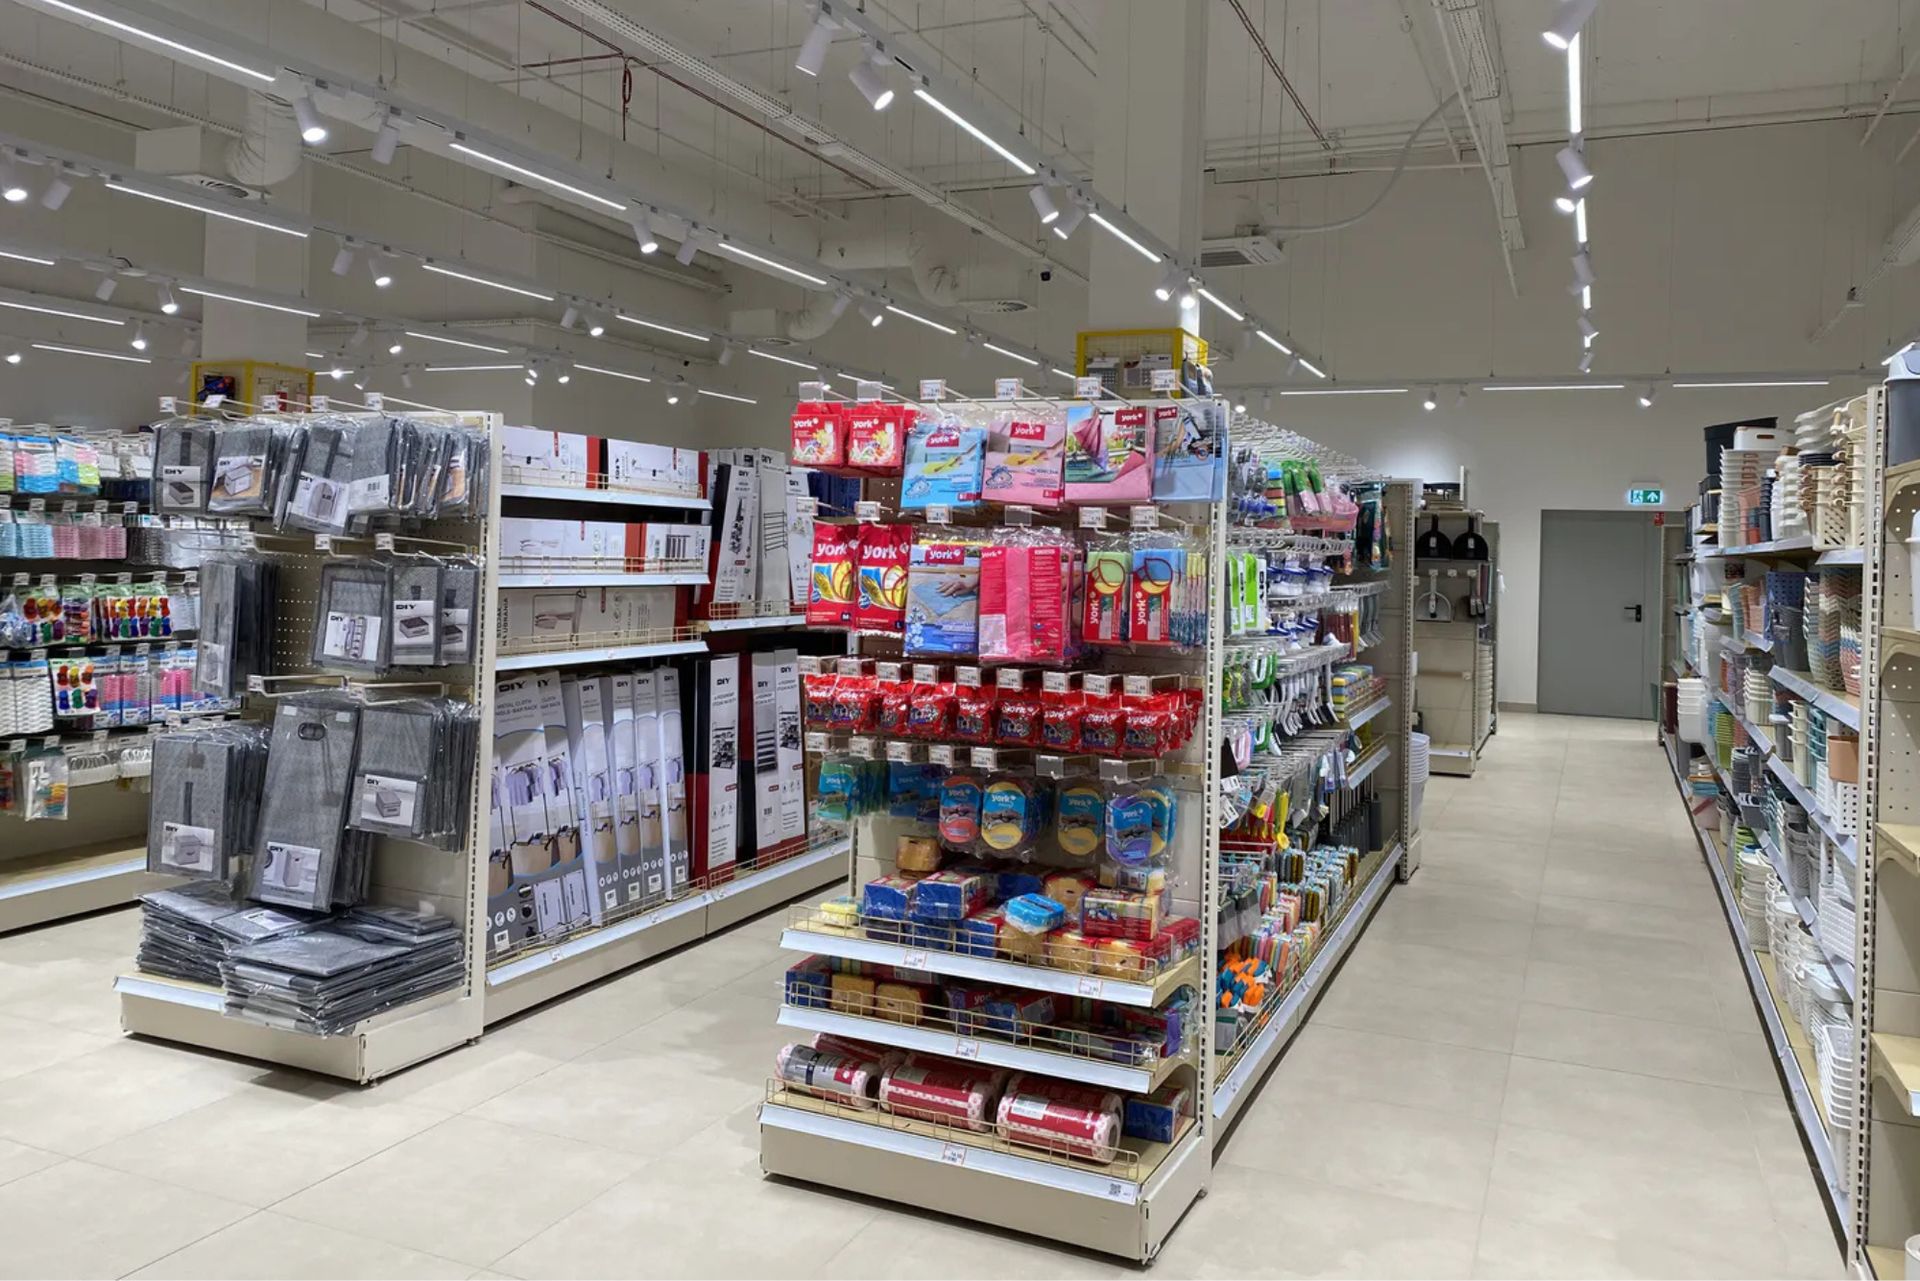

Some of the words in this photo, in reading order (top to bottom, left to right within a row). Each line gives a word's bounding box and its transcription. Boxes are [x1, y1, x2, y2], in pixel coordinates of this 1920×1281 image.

[1121, 413, 1138, 422] york
[1158, 410, 1172, 418] york
[793, 419, 813, 429] york
[853, 419, 873, 429] york
[1014, 425, 1036, 436] york
[930, 434, 950, 444] york
[816, 542, 848, 557] york
[862, 545, 898, 560] york
[929, 550, 953, 560] york
[980, 551, 999, 559] york
[1089, 599, 1100, 625] york
[1137, 599, 1147, 625] york
[498, 680, 526, 692] DIY
[637, 677, 650, 685] DIY
[717, 677, 731, 686] DIY
[992, 794, 1011, 802] york
